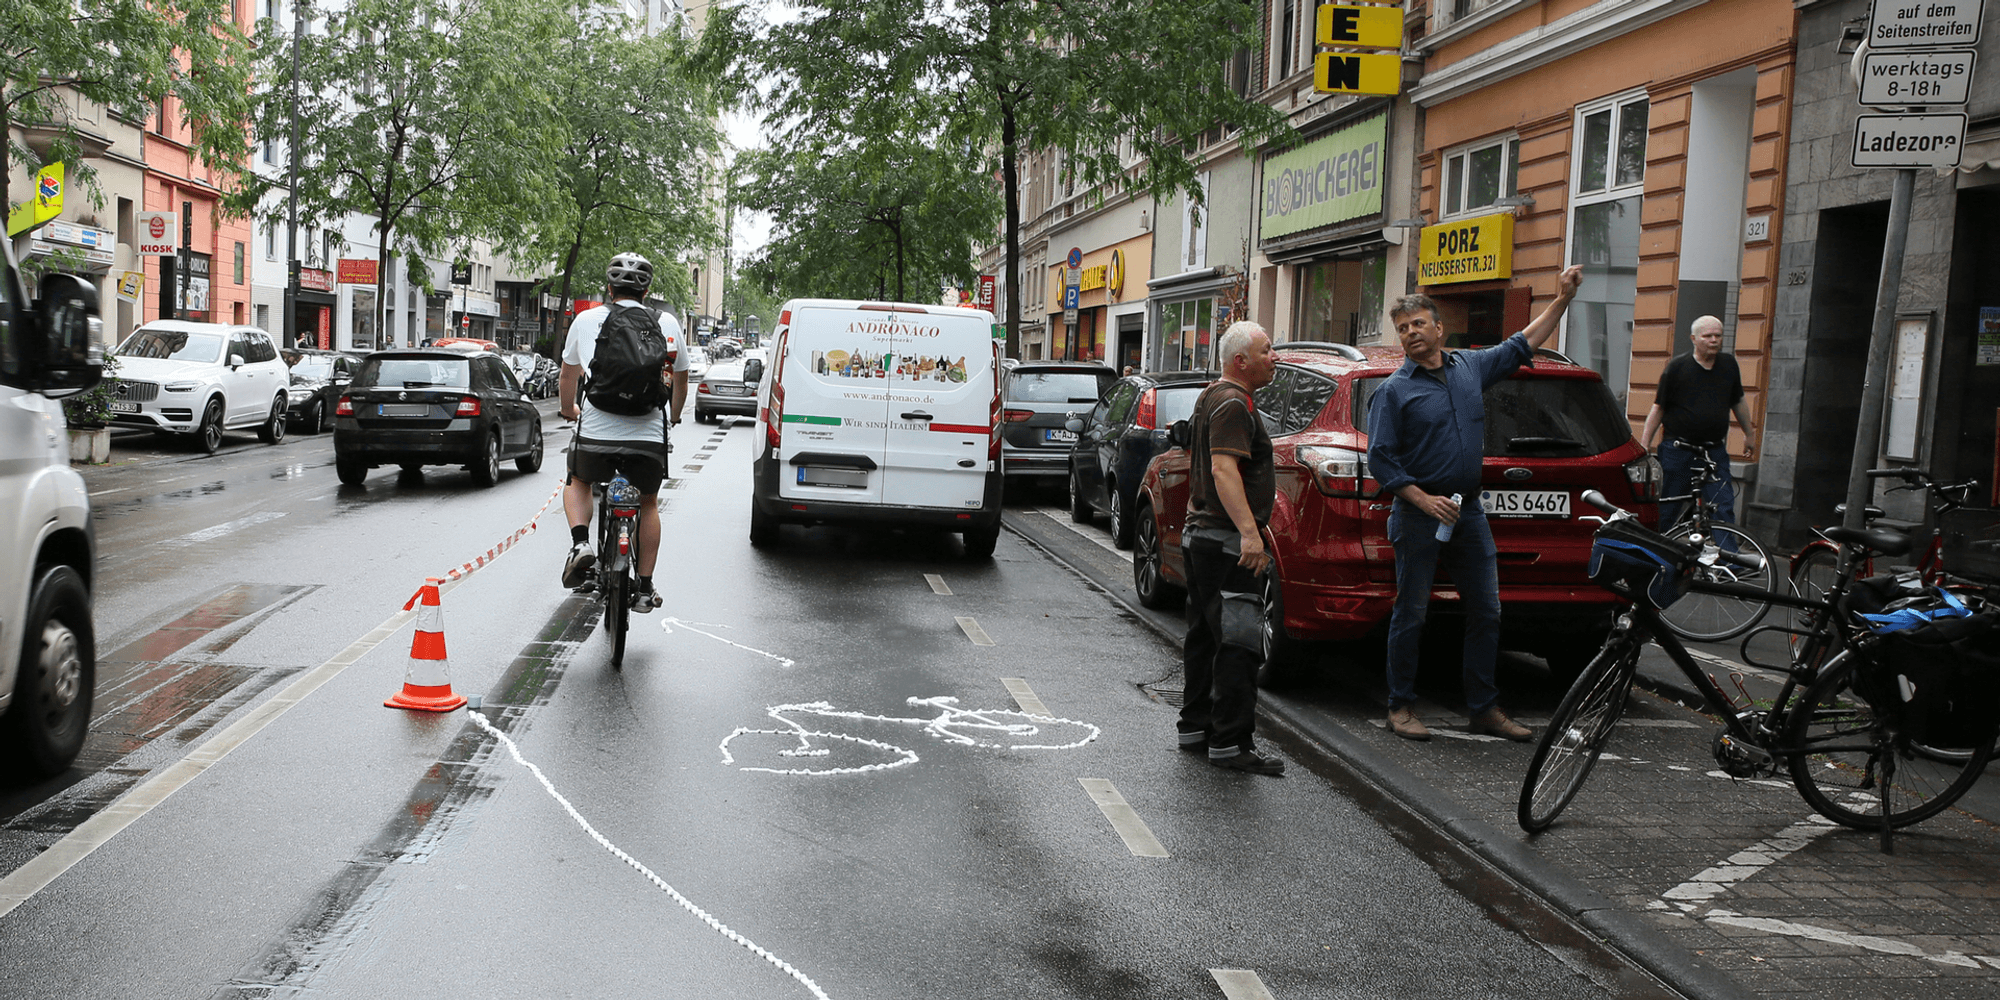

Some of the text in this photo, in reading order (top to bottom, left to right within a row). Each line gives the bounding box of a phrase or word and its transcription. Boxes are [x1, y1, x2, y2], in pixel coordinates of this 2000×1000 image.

[1898, 3, 1956, 19] auf dem
[1877, 21, 1972, 39] Seitenstreifen
[1872, 60, 1964, 79] werktags
[1265, 141, 1379, 219] BIOBÄCKEREI
[1747, 221, 1766, 237] 321
[140, 244, 173, 254] KIOSK
[1437, 225, 1480, 257] PORZ
[980, 281, 993, 306] früh
[845, 321, 940, 338] ANDRONACO
[872, 335, 913, 343] Supermarkt
[843, 392, 935, 404] www.andronaco.de
[1495, 492, 1567, 512] AS 6467
